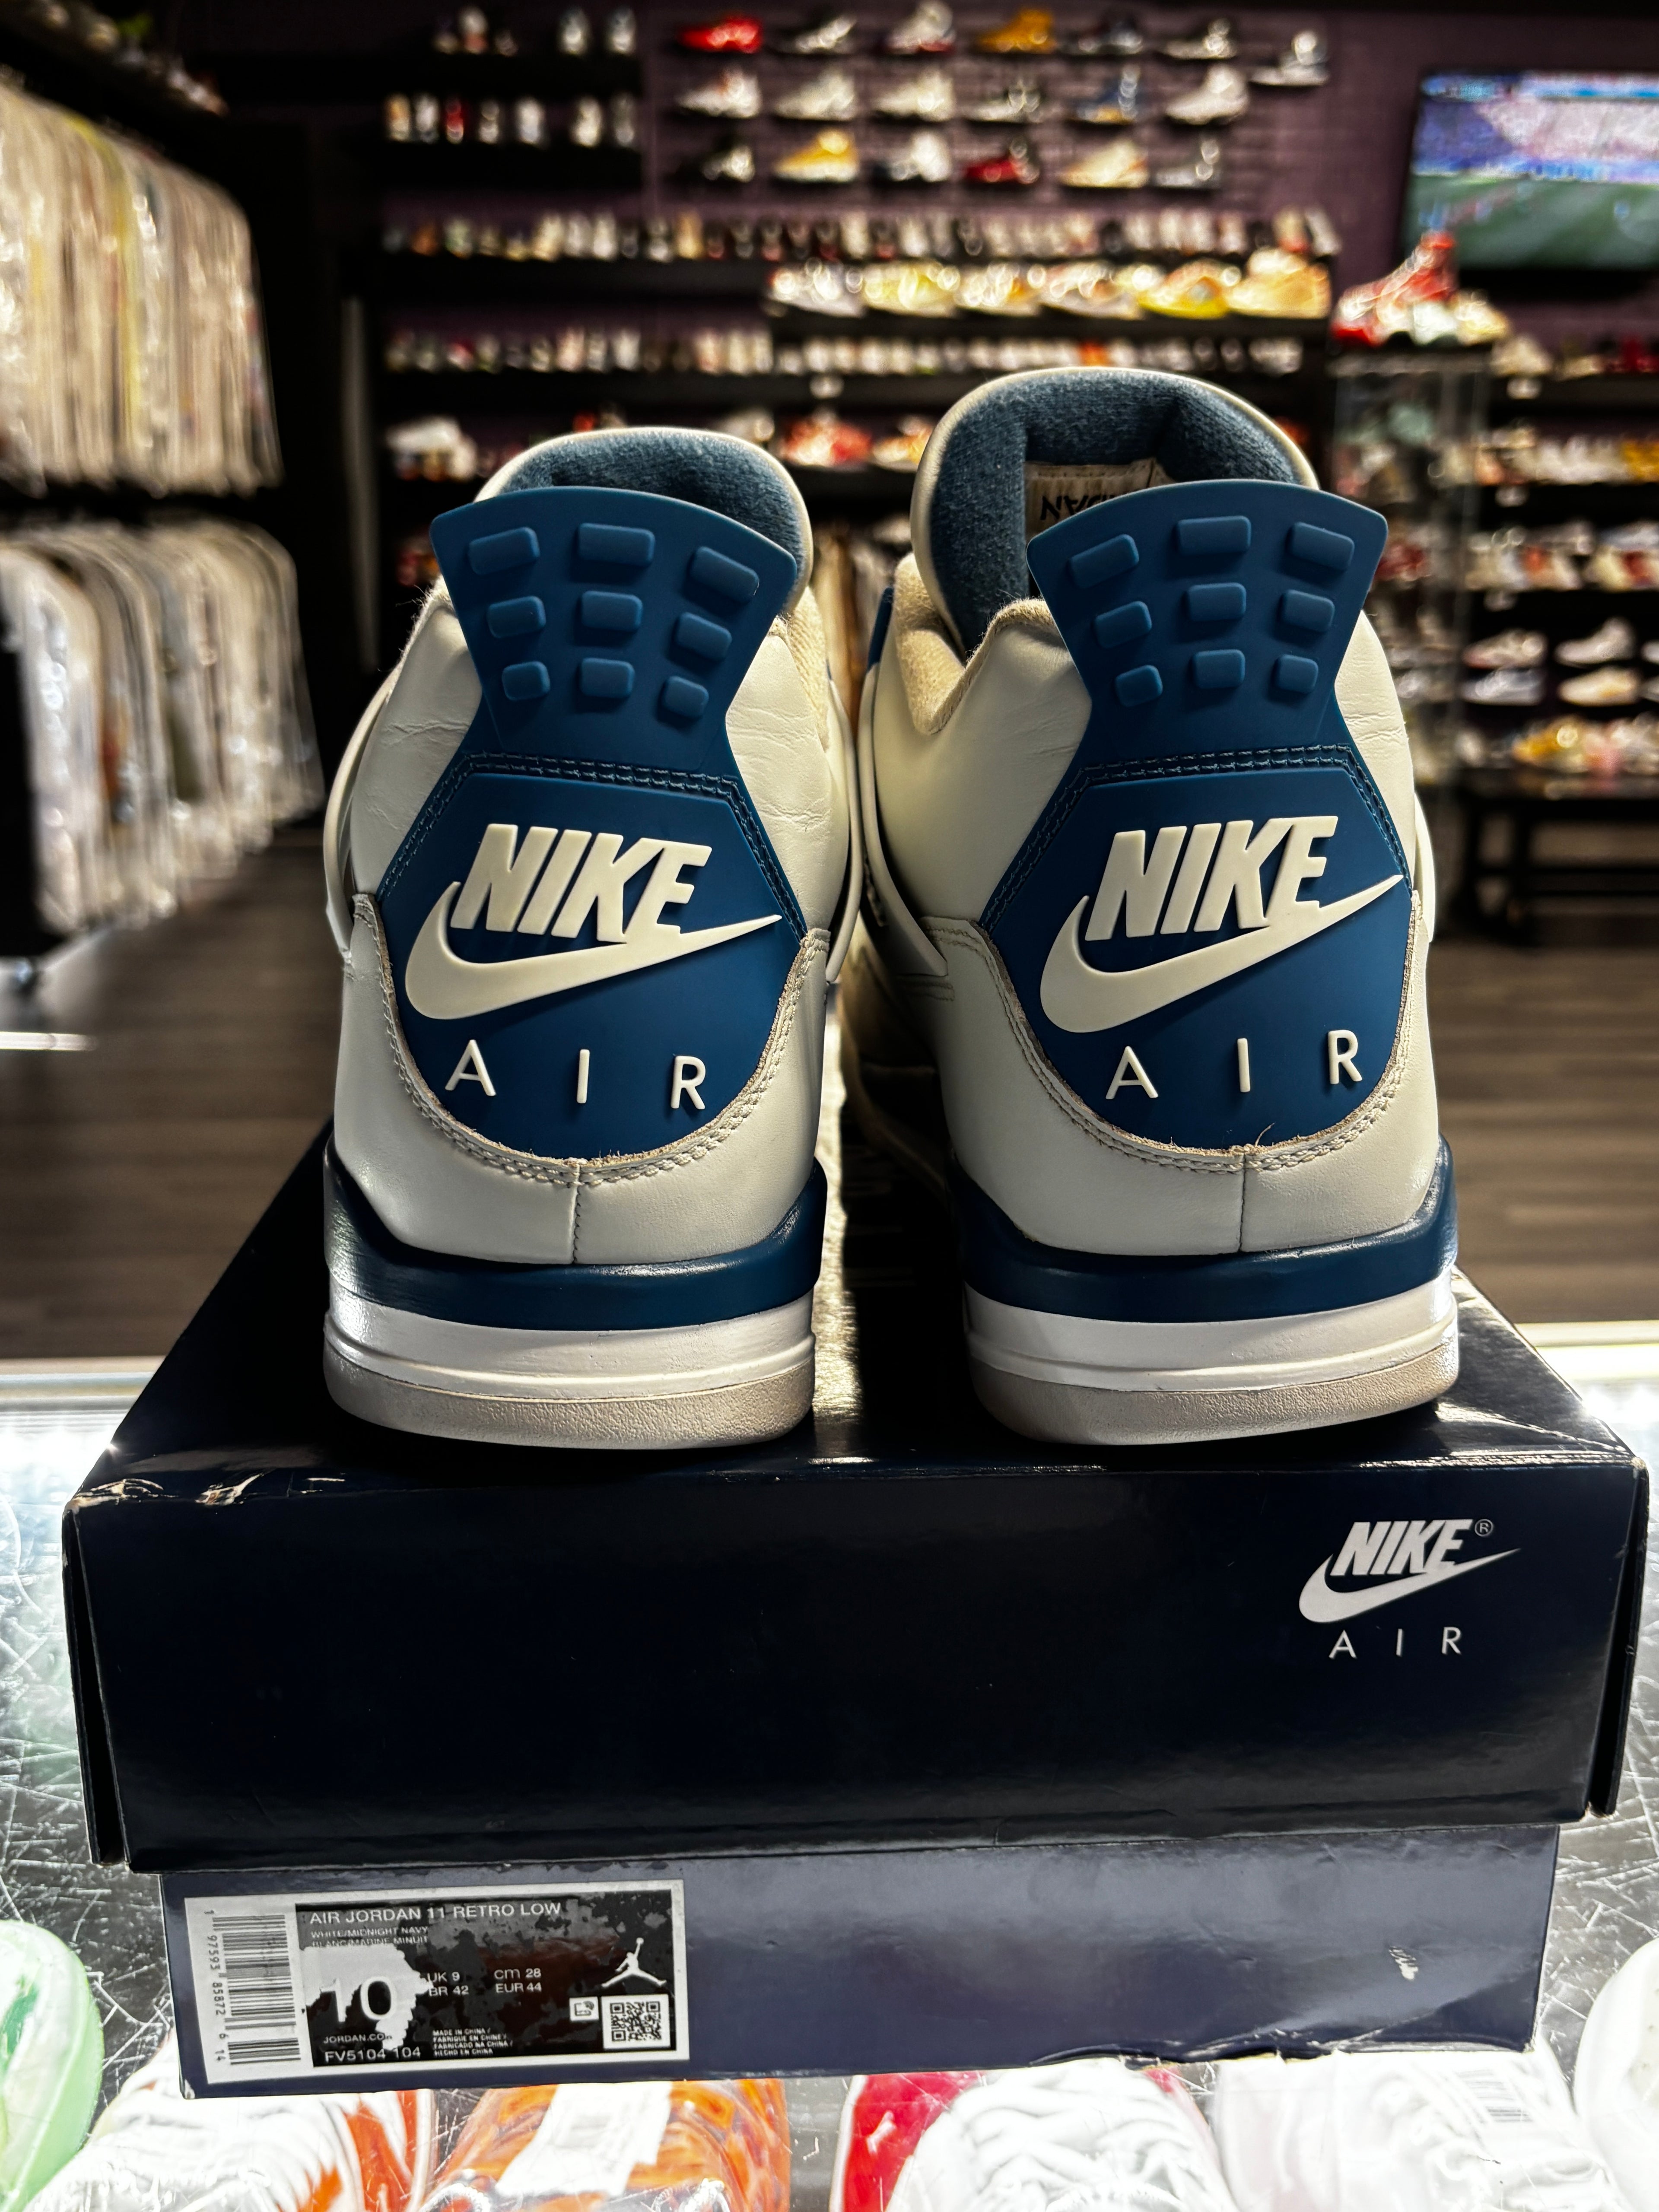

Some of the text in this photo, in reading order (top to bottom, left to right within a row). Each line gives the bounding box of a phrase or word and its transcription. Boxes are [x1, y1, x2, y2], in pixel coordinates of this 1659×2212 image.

[451, 823, 712, 943] NIKE
[1084, 815, 1338, 941] NIKE
[445, 1039, 706, 1109] AIR
[1106, 1030, 1362, 1099] AIR
[1330, 1519, 1473, 1576] NIKE
[1328, 1627, 1461, 1659] AIR
[310, 1902, 561, 1924] AIR JORDAN 11 RETRO LOW
[393, 1936, 428, 1945] MINUIT
[401, 1926, 428, 1934] NAVY
[207, 1935, 220, 1970] 97593
[427, 1971, 461, 1983] UK 9
[525, 1967, 542, 1978] 28
[212, 1982, 226, 2016] 85872
[429, 1985, 469, 1996] BR 42
[496, 1982, 542, 1993] EUR 44
[433, 2035, 467, 2043] FABRIQUE
